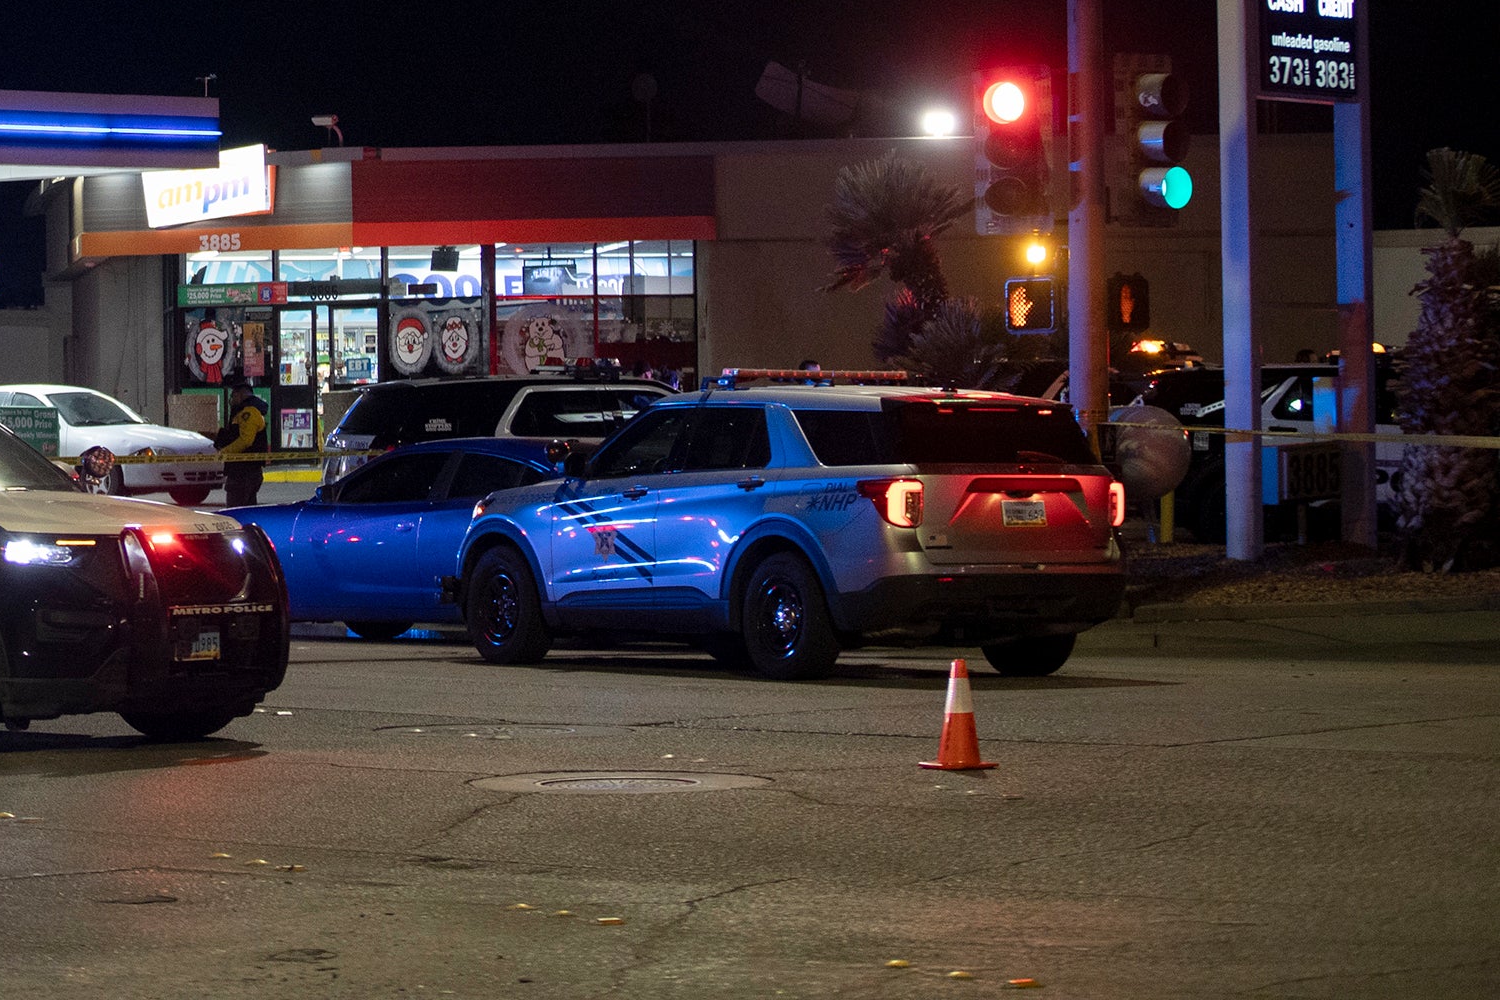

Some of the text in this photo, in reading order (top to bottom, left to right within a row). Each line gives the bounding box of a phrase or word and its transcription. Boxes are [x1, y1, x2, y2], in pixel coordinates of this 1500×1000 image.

[1271, 32, 1351, 53] unleaded gasoline
[199, 233, 241, 251] 3885
[348, 359, 369, 370] EBT
[1289, 452, 1341, 497] 3885
[172, 604, 273, 615] METRO POLICE
